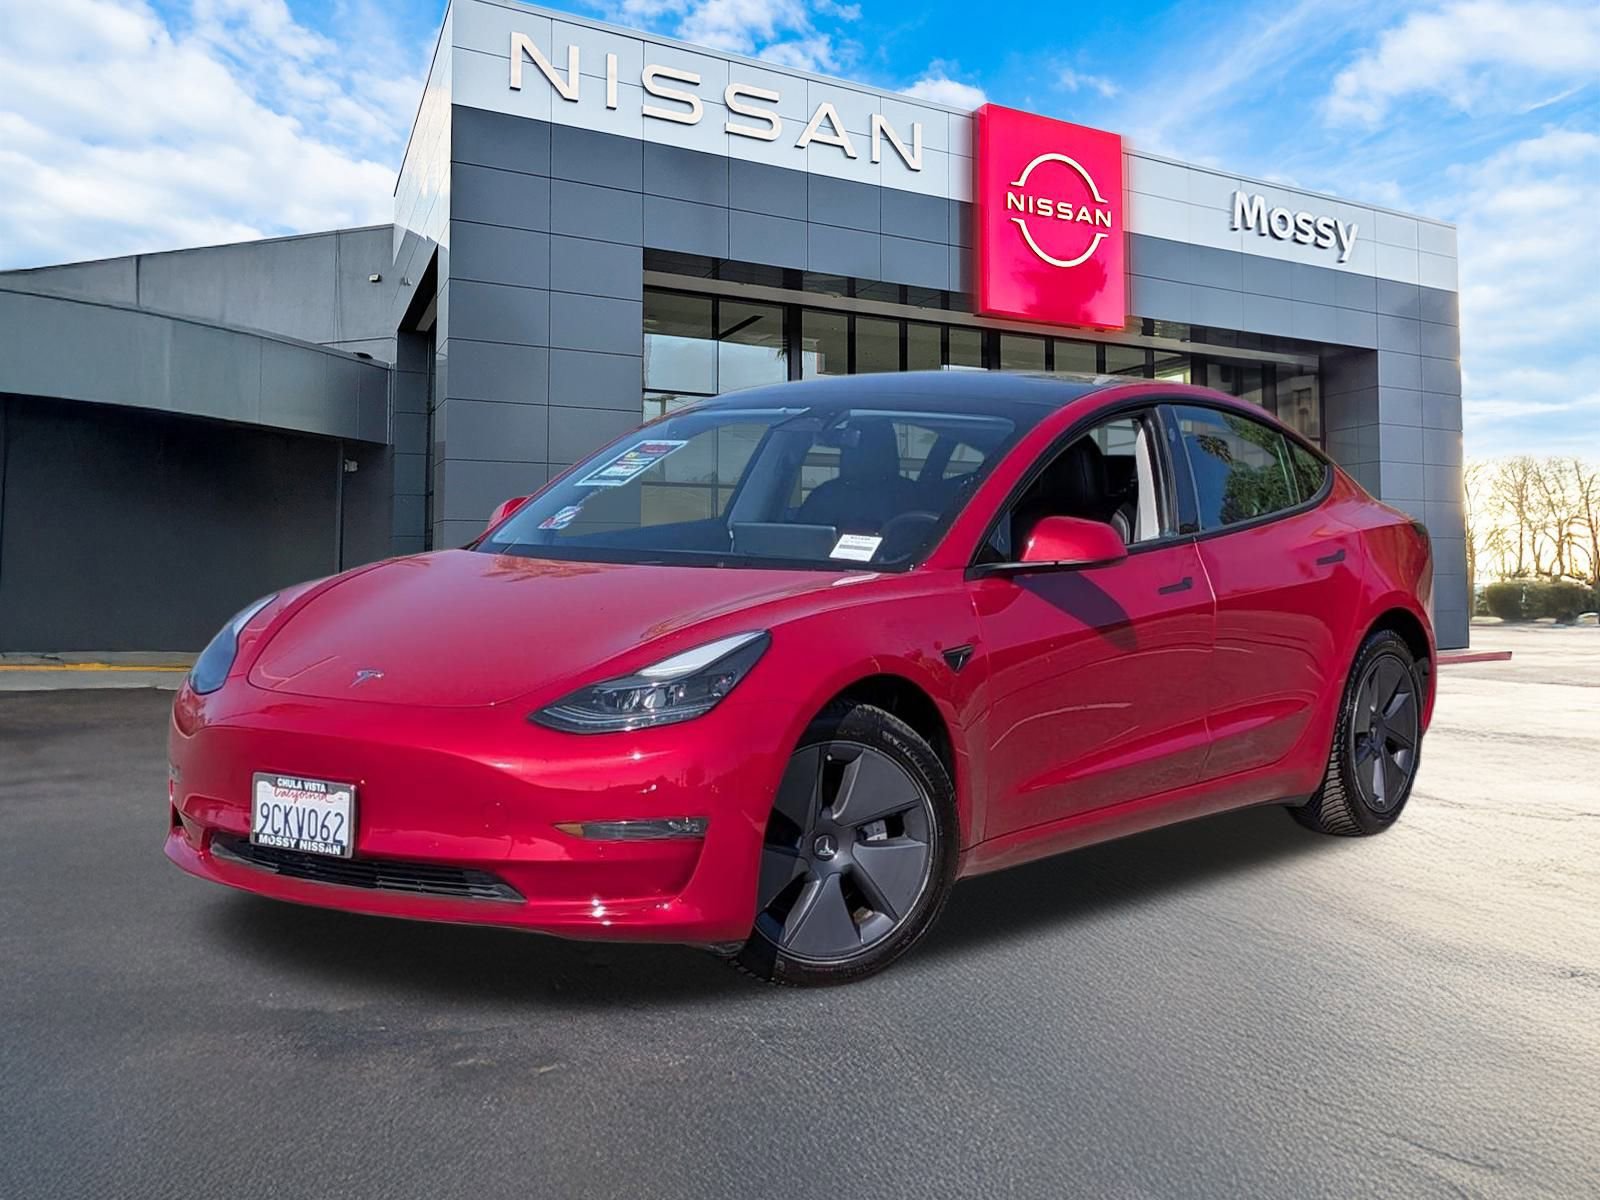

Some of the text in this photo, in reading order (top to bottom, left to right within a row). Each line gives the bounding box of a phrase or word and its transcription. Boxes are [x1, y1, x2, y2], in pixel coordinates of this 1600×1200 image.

[509, 31, 922, 172] NISSAN
[1007, 191, 1112, 228] NISSAN
[1231, 190, 1358, 263] Mossy
[277, 778, 326, 792] CHULA VISTA
[259, 802, 344, 845] 9CKV062
[259, 834, 341, 855] MOSSY NISSAN
